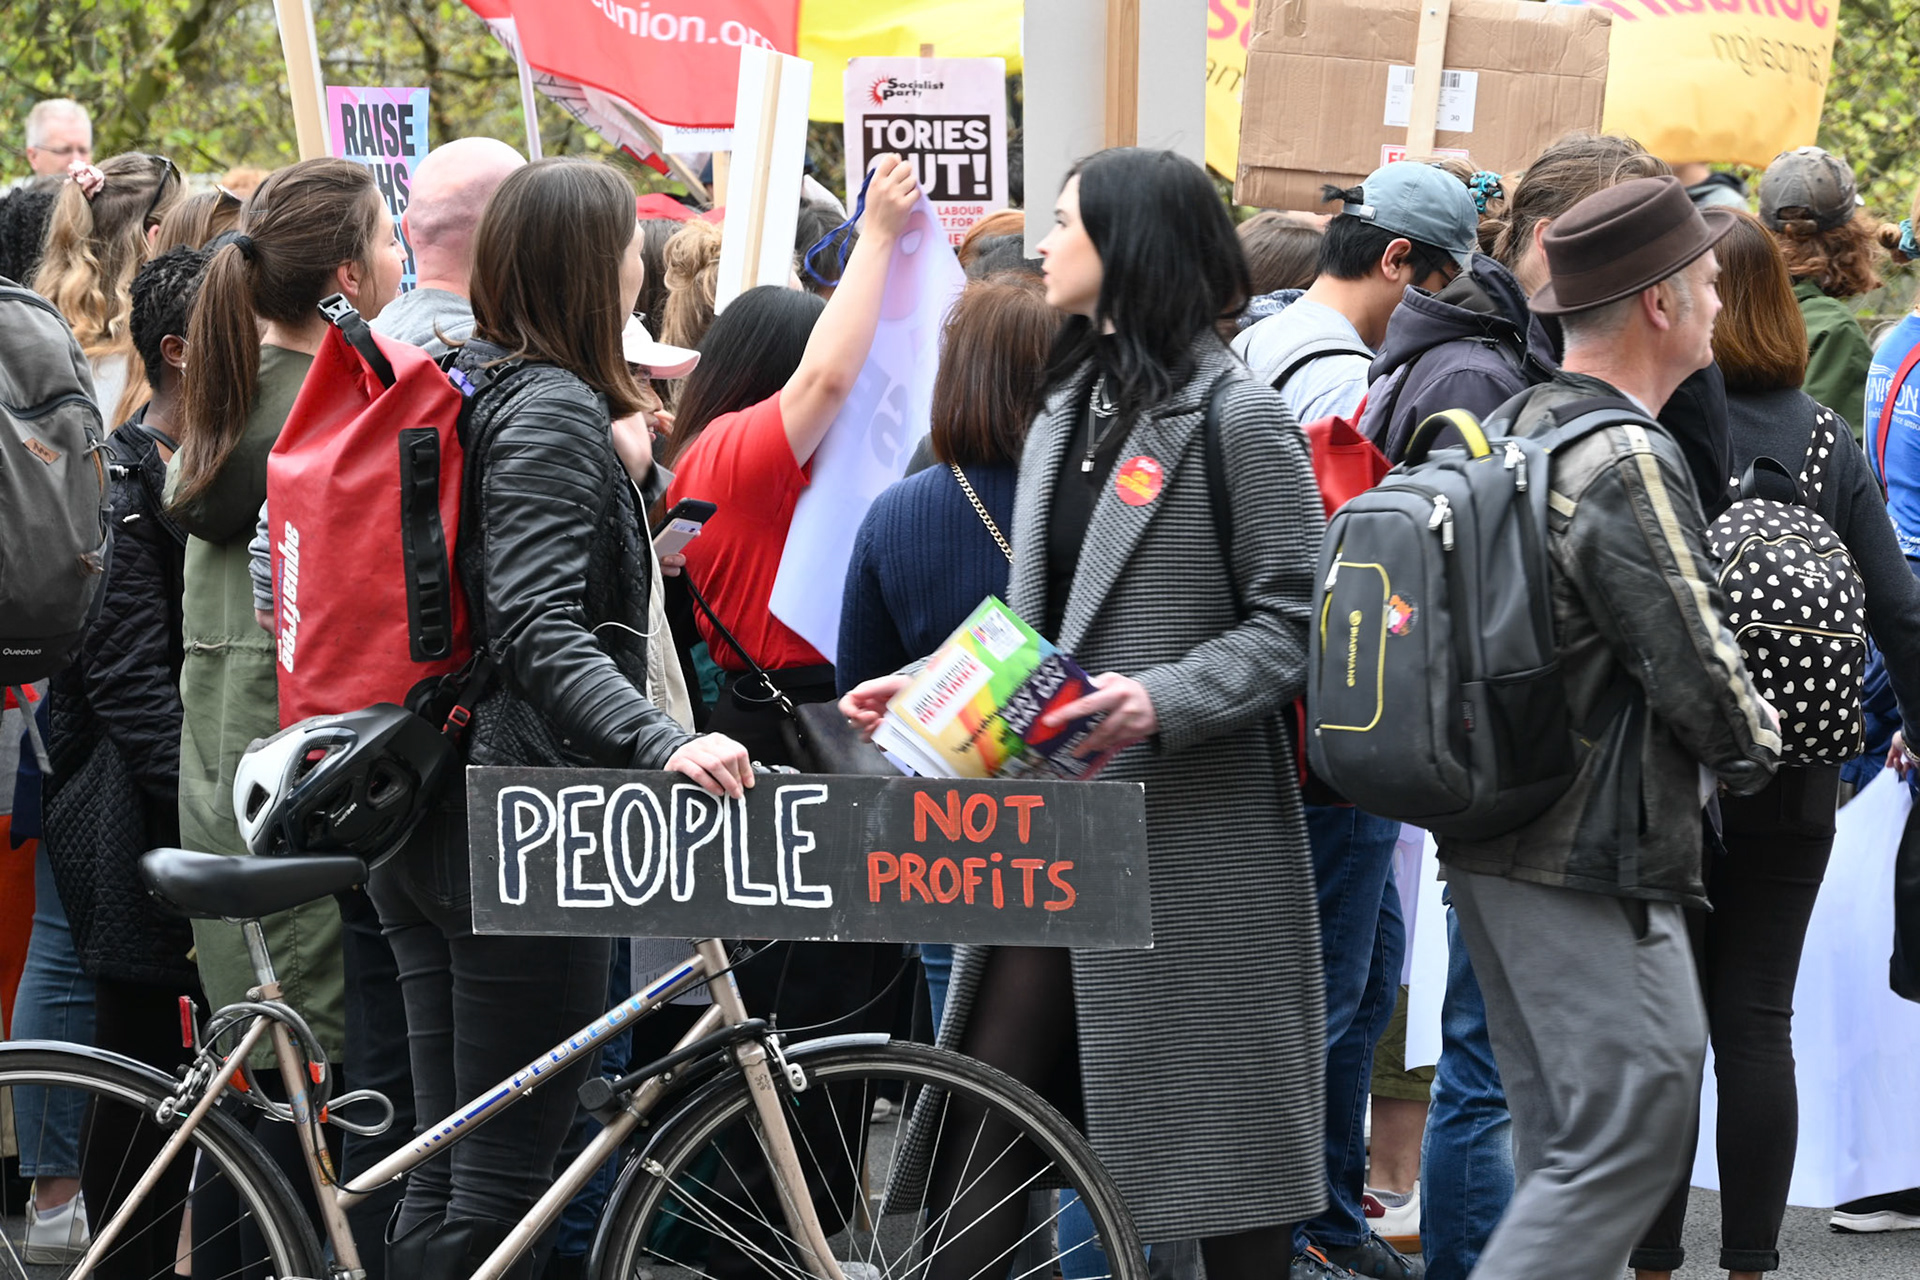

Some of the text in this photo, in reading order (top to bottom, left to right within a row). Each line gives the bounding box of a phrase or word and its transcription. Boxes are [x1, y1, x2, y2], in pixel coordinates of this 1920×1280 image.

[888, 78, 944, 89] Socialist
[341, 103, 415, 157] RAISE
[864, 119, 988, 150] TORIES
[368, 162, 410, 216] HS
[938, 206, 984, 215] LABOUR
[951, 217, 974, 227] FOR
[277, 520, 300, 674] aquafree
[913, 788, 1045, 845] NOT
[496, 783, 833, 910] PEOPLE
[513, 994, 643, 1090] PEUGEOT
